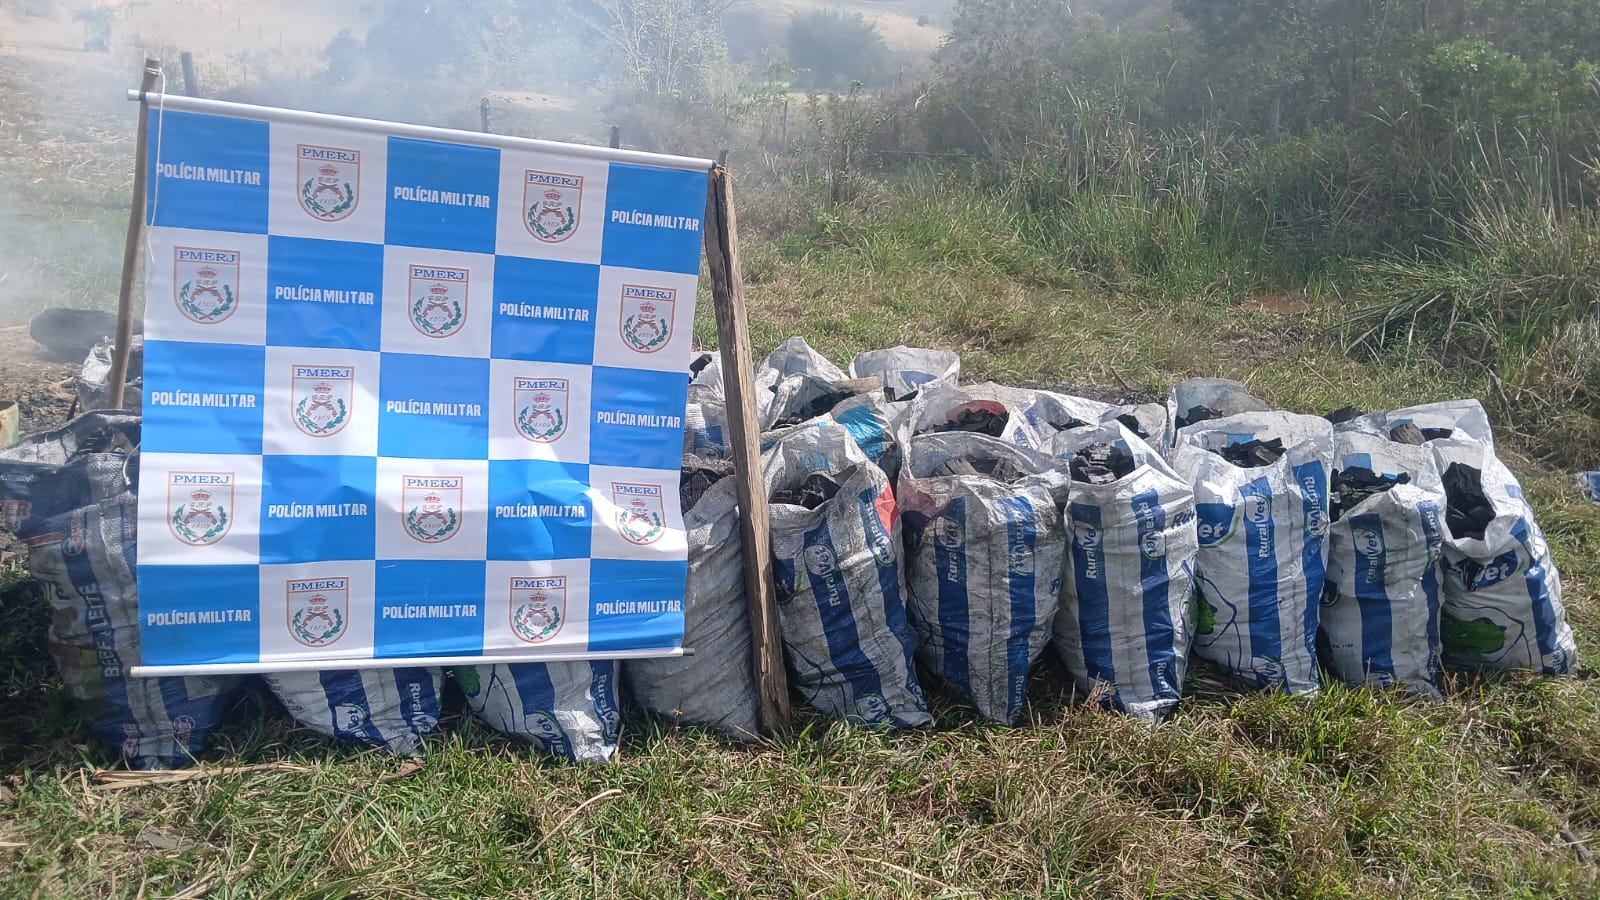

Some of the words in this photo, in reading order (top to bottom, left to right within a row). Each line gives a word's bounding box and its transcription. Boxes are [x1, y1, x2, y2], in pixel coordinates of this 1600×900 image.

[302, 148, 355, 161] PMERJ
[207, 168, 260, 185] MILITAR
[527, 173, 579, 186] PMERJ
[395, 186, 438, 203] POLÍCIA
[441, 192, 489, 208] MILITAR
[612, 210, 652, 226] POLÍCIA
[654, 215, 699, 231] MILITAR
[178, 251, 236, 263] PMERJ
[413, 268, 465, 280] PMERJ
[276, 285, 321, 301] POLÍCIA
[324, 290, 373, 304] MILITAR
[625, 287, 672, 300] PMERJ
[500, 302, 541, 318] POLÍCIA
[544, 307, 588, 321] MILITAR
[296, 368, 350, 378] PMERJ
[517, 380, 565, 390] PMERJ
[152, 390, 200, 406] POLÍCIA
[203, 394, 255, 407] MILITAR
[387, 399, 431, 414] POLÍCIA
[433, 403, 480, 416] MILITAR
[597, 413, 635, 425] POLÍCIA
[638, 415, 680, 428] MILITAR
[173, 475, 230, 484] PMERJ
[407, 478, 459, 489] PMERJ
[615, 485, 658, 495] PMERJ
[269, 502, 314, 517] POLÍCIA
[316, 504, 366, 517] MILITAR
[496, 503, 537, 517] POLÍCIA
[540, 506, 585, 517] MILITAR
[1254, 500, 1268, 558] RuralVet
[947, 523, 959, 583] RuralVet
[1082, 528, 1097, 579] RuralVe
[514, 578, 563, 588] PMERJ
[814, 547, 841, 607] RuralVet
[291, 580, 345, 591] PMERJ
[383, 604, 426, 618] POLÍCIA
[429, 605, 476, 617] MILITAR
[596, 600, 635, 614] POLÍCIA
[638, 600, 681, 613] MILITAR
[148, 610, 196, 625] POLÍCIA
[199, 610, 250, 623] MILITAR
